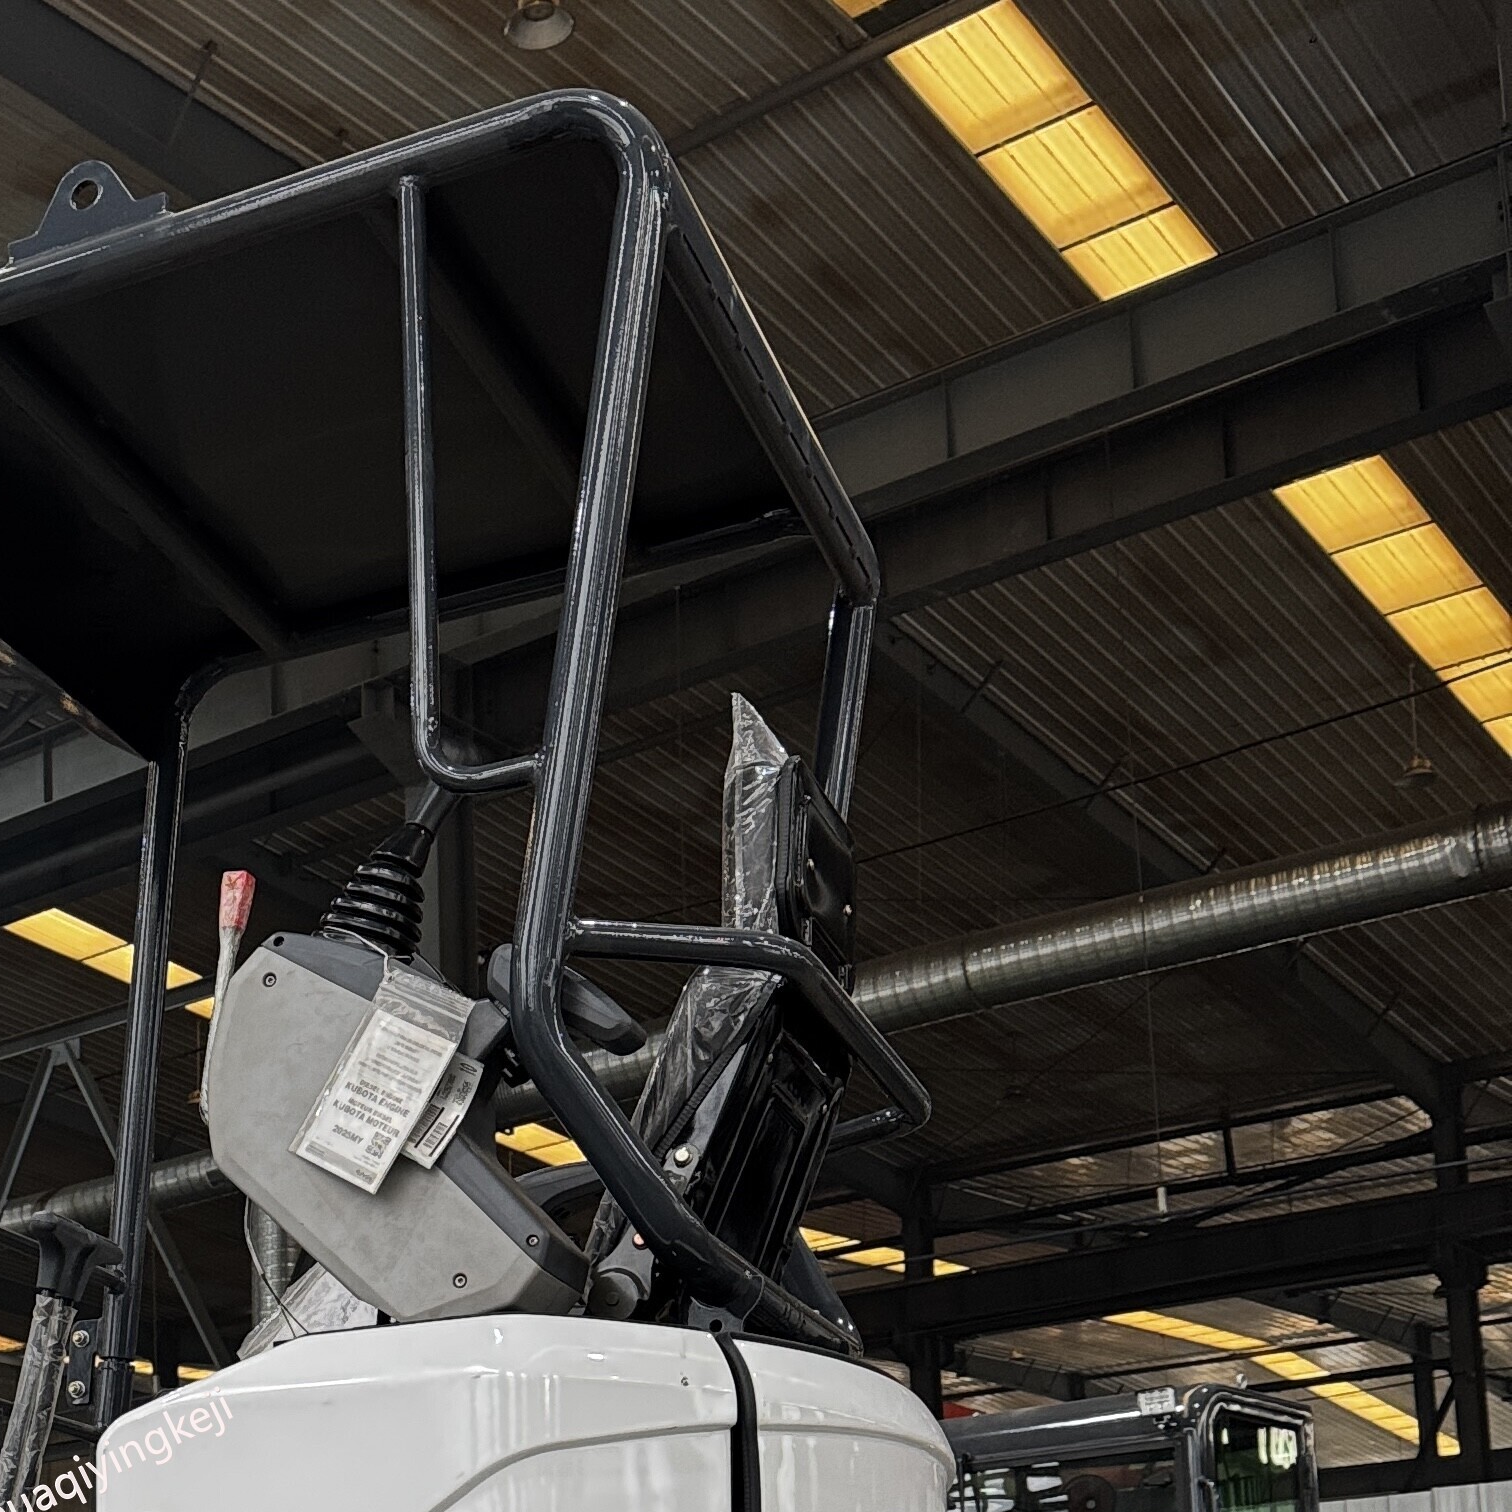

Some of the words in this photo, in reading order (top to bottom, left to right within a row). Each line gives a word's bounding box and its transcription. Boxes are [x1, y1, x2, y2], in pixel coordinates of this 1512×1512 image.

[333, 1099, 365, 1121] KUBOTA
[366, 1114, 400, 1137] MOTEUR
[345, 1081, 378, 1102] KUBOTA
[378, 1097, 410, 1118] ENGINE
